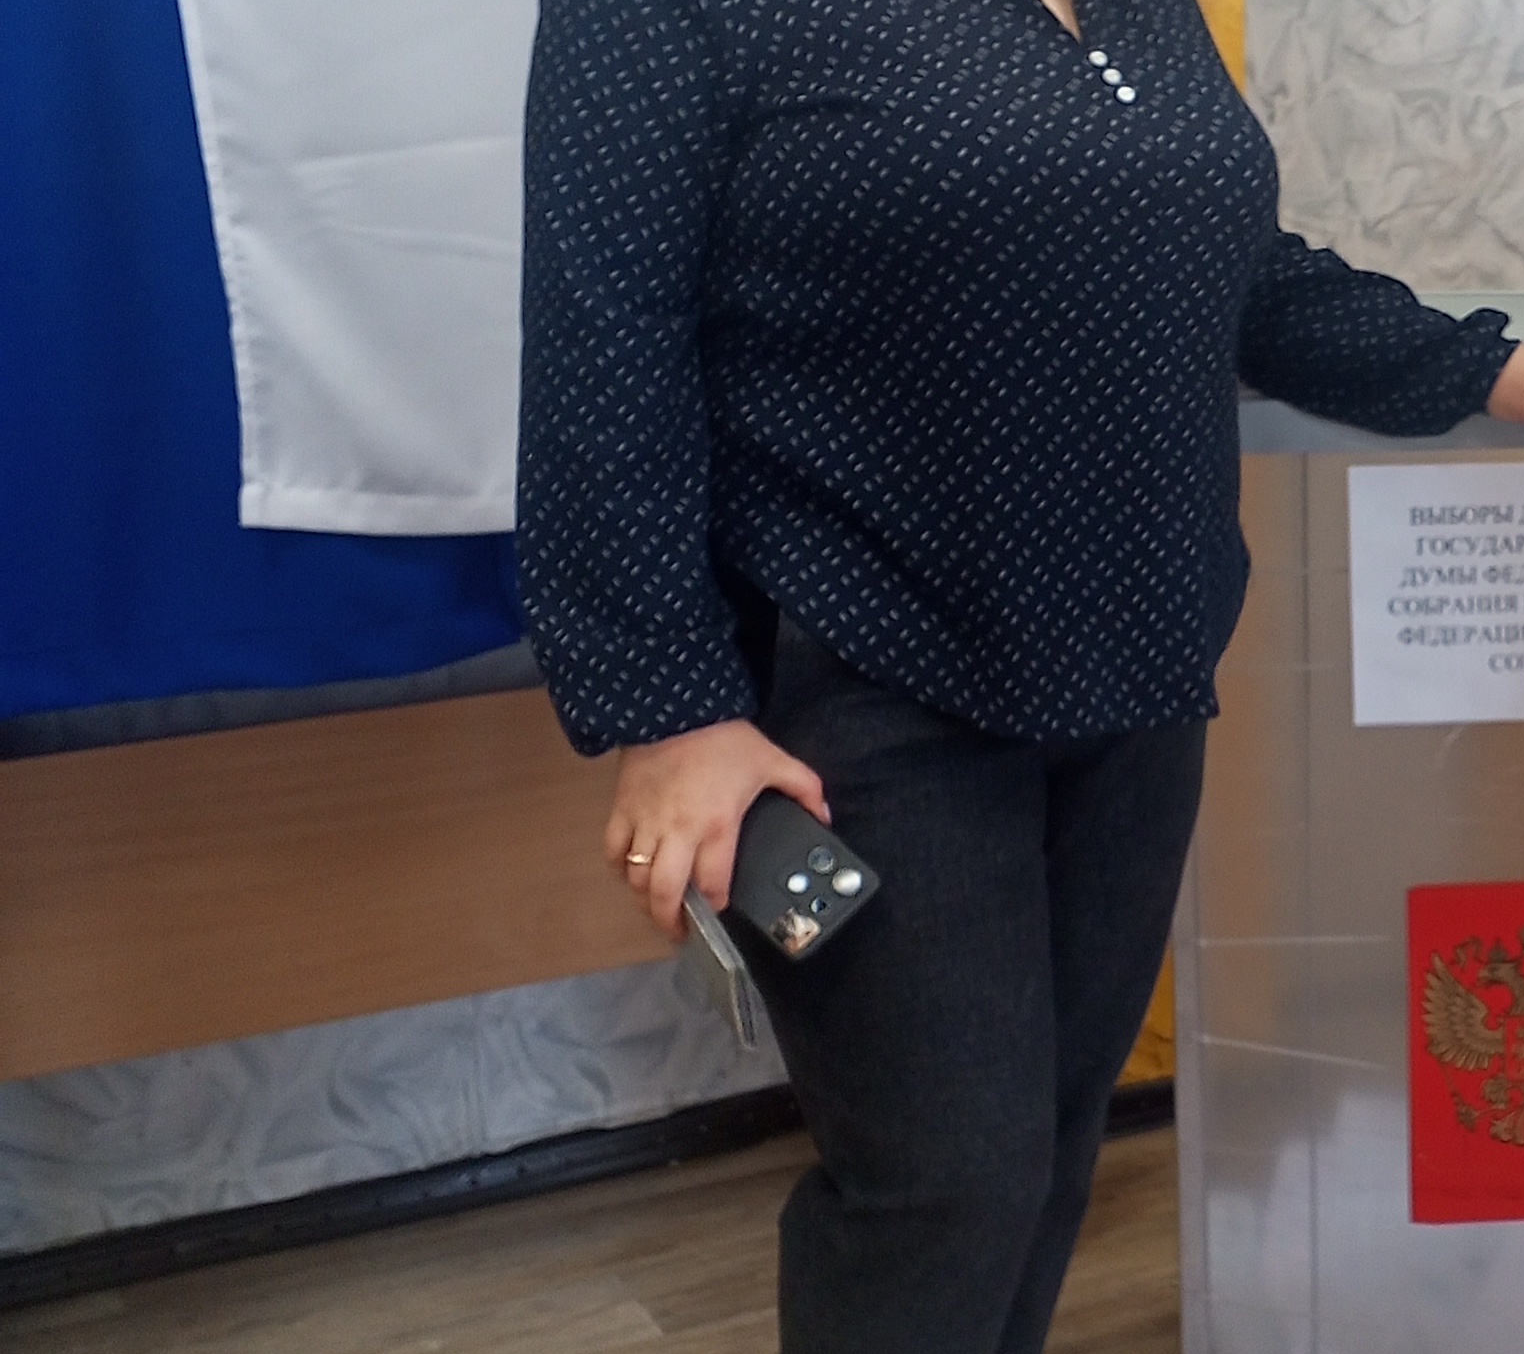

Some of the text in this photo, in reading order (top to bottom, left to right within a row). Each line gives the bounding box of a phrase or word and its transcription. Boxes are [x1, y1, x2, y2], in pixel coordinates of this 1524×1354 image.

[1409, 503, 1515, 527] ВЫБОРЫ
[1399, 565, 1478, 589] ДУМЫ
[1387, 595, 1519, 617] СОБРАНИЯ
